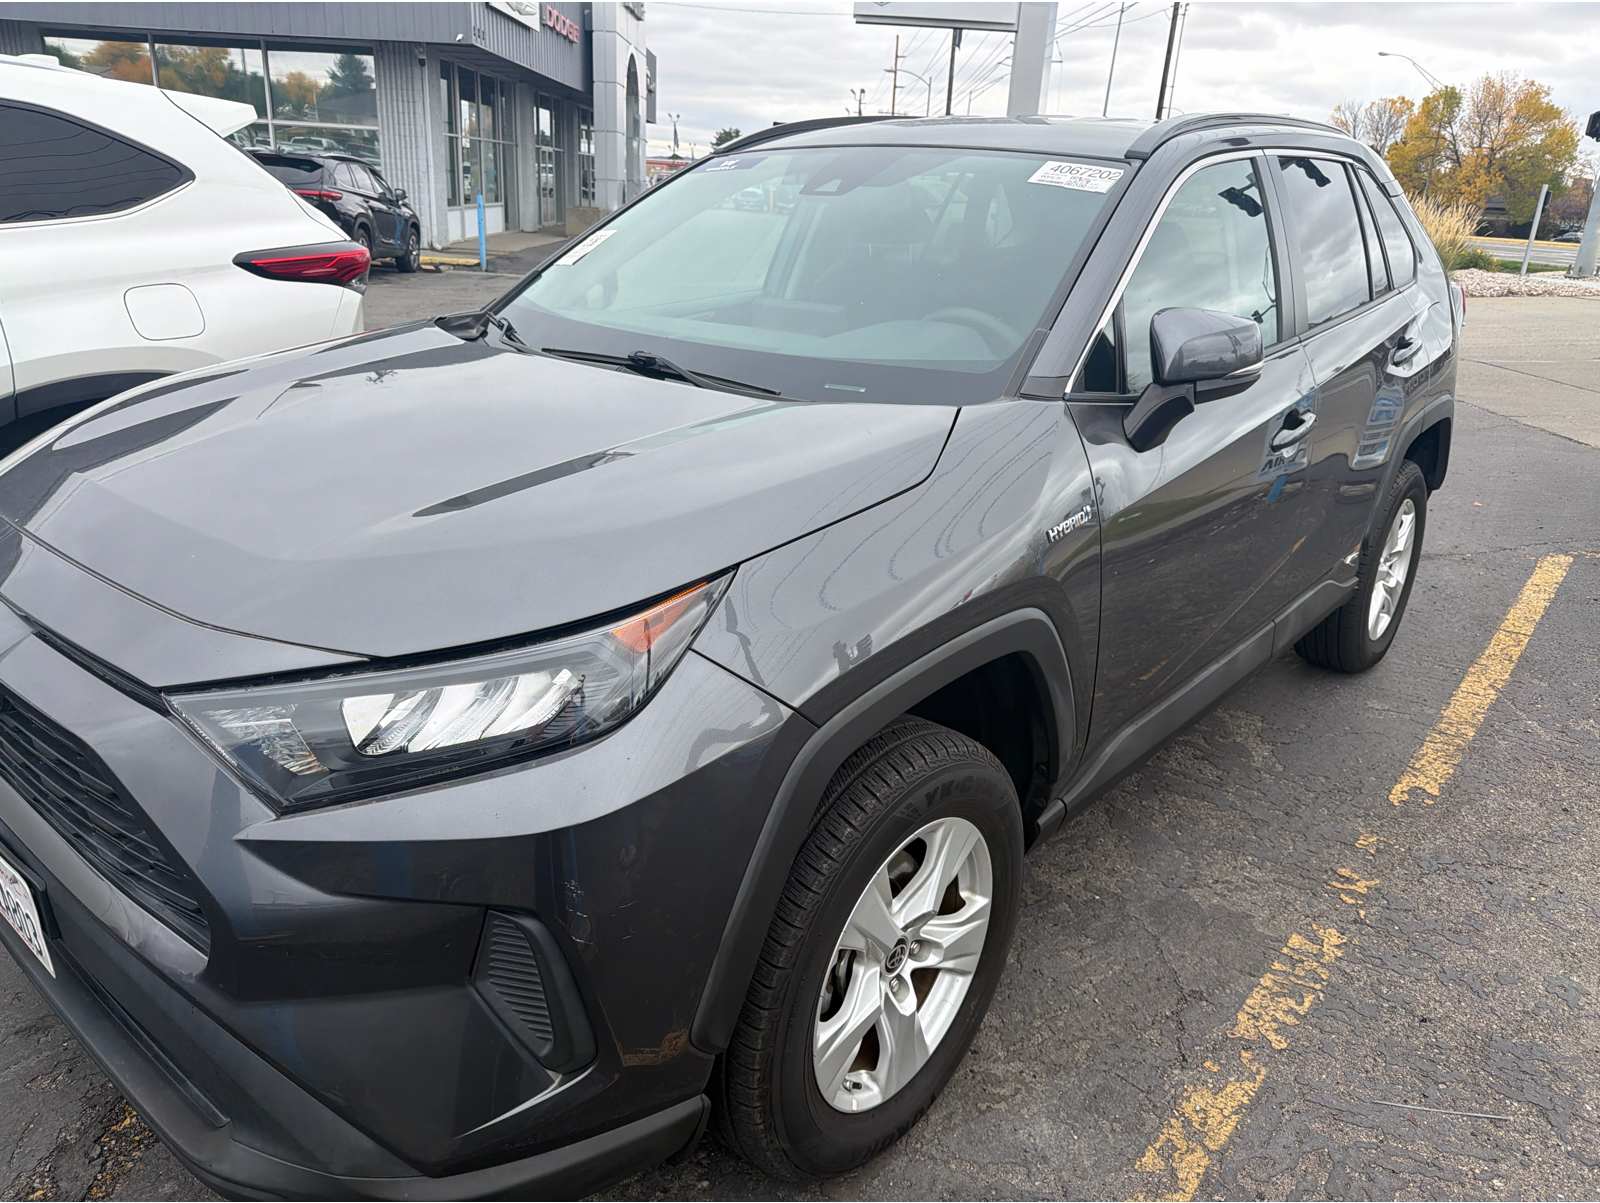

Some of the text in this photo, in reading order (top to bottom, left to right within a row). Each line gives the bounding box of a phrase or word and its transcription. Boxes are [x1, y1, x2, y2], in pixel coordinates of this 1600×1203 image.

[546, 5, 581, 43] DODGE
[1050, 164, 1122, 181] 4067202
[1047, 511, 1086, 543] HYBRID
